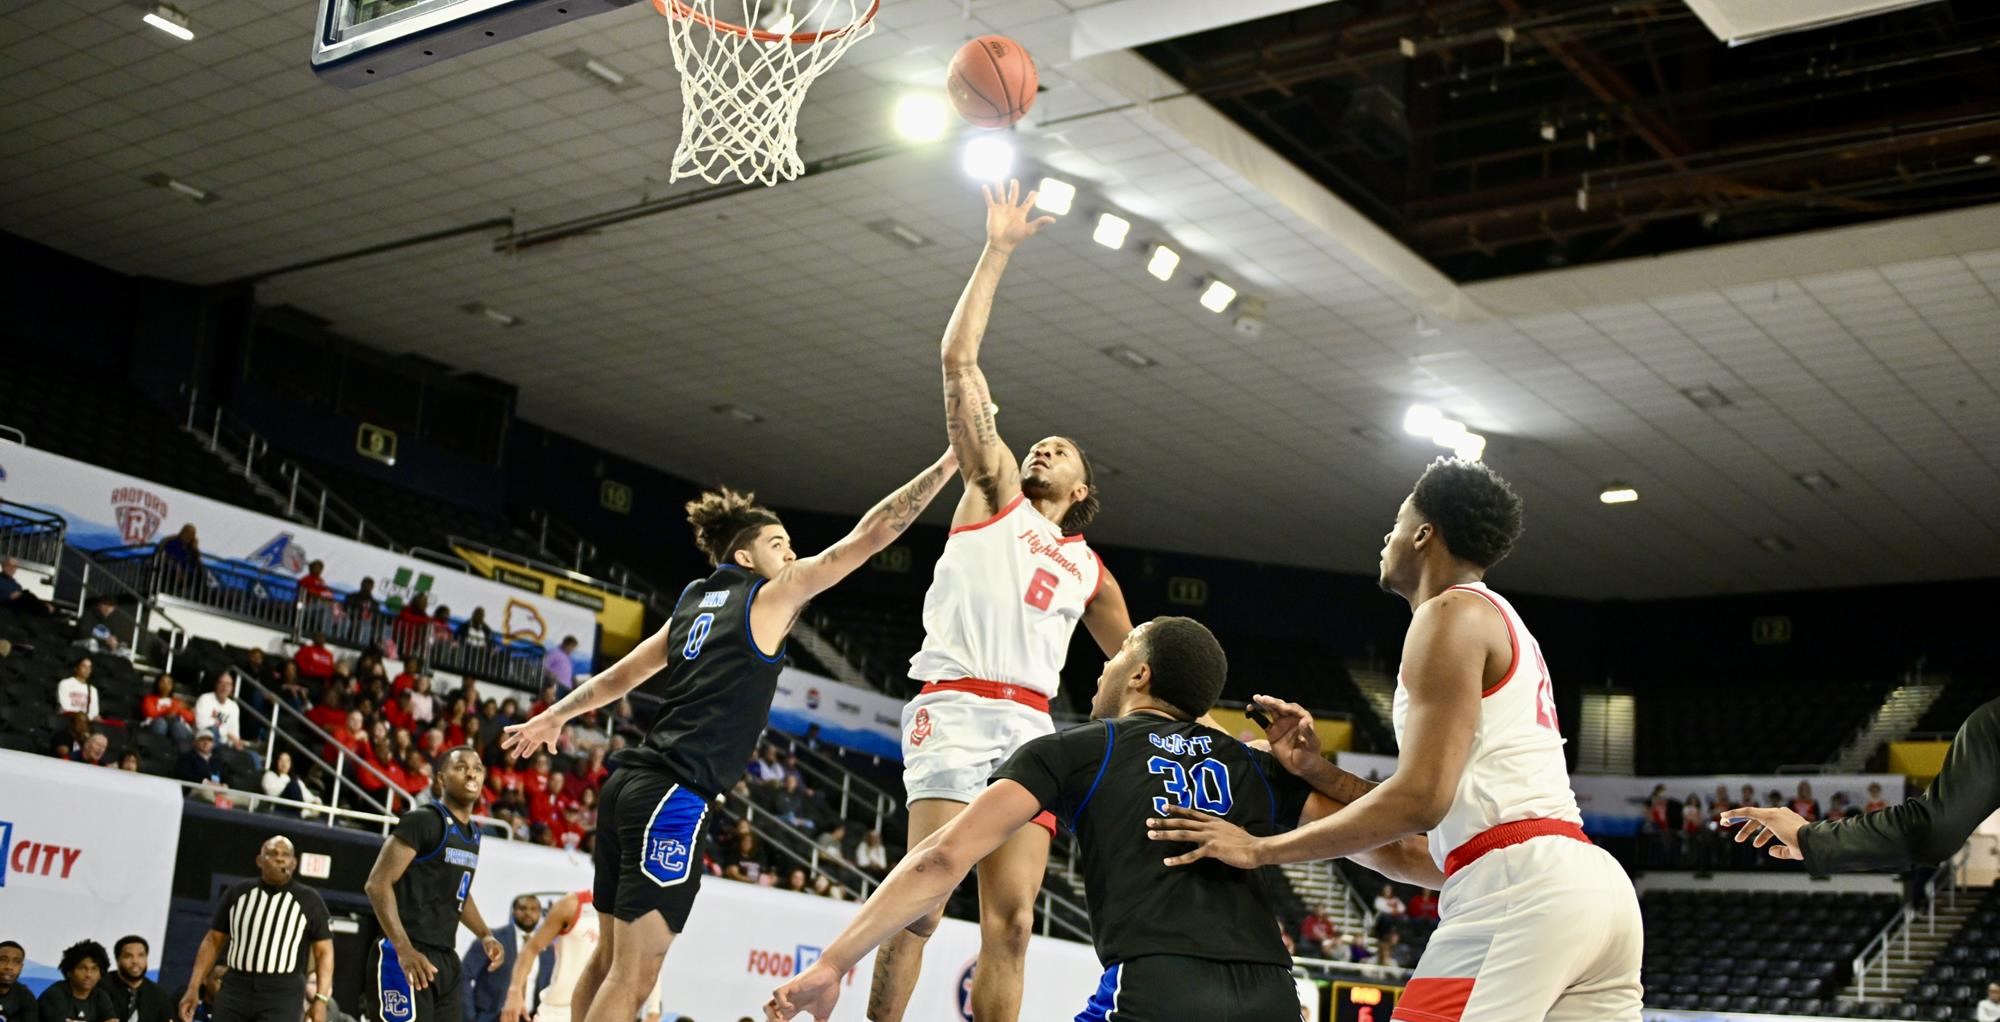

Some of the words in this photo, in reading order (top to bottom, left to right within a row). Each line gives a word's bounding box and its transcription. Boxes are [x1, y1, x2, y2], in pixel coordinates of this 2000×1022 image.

[371, 431, 384, 453] 9
[111, 486, 169, 519] RADFORD
[1023, 567, 1060, 612] 6
[683, 612, 715, 660] 0
[1147, 755, 1234, 817] 30
[10, 840, 83, 879] CITY
[650, 837, 687, 872] PC
[747, 949, 794, 977] FOOD
[383, 989, 409, 1016] PC
